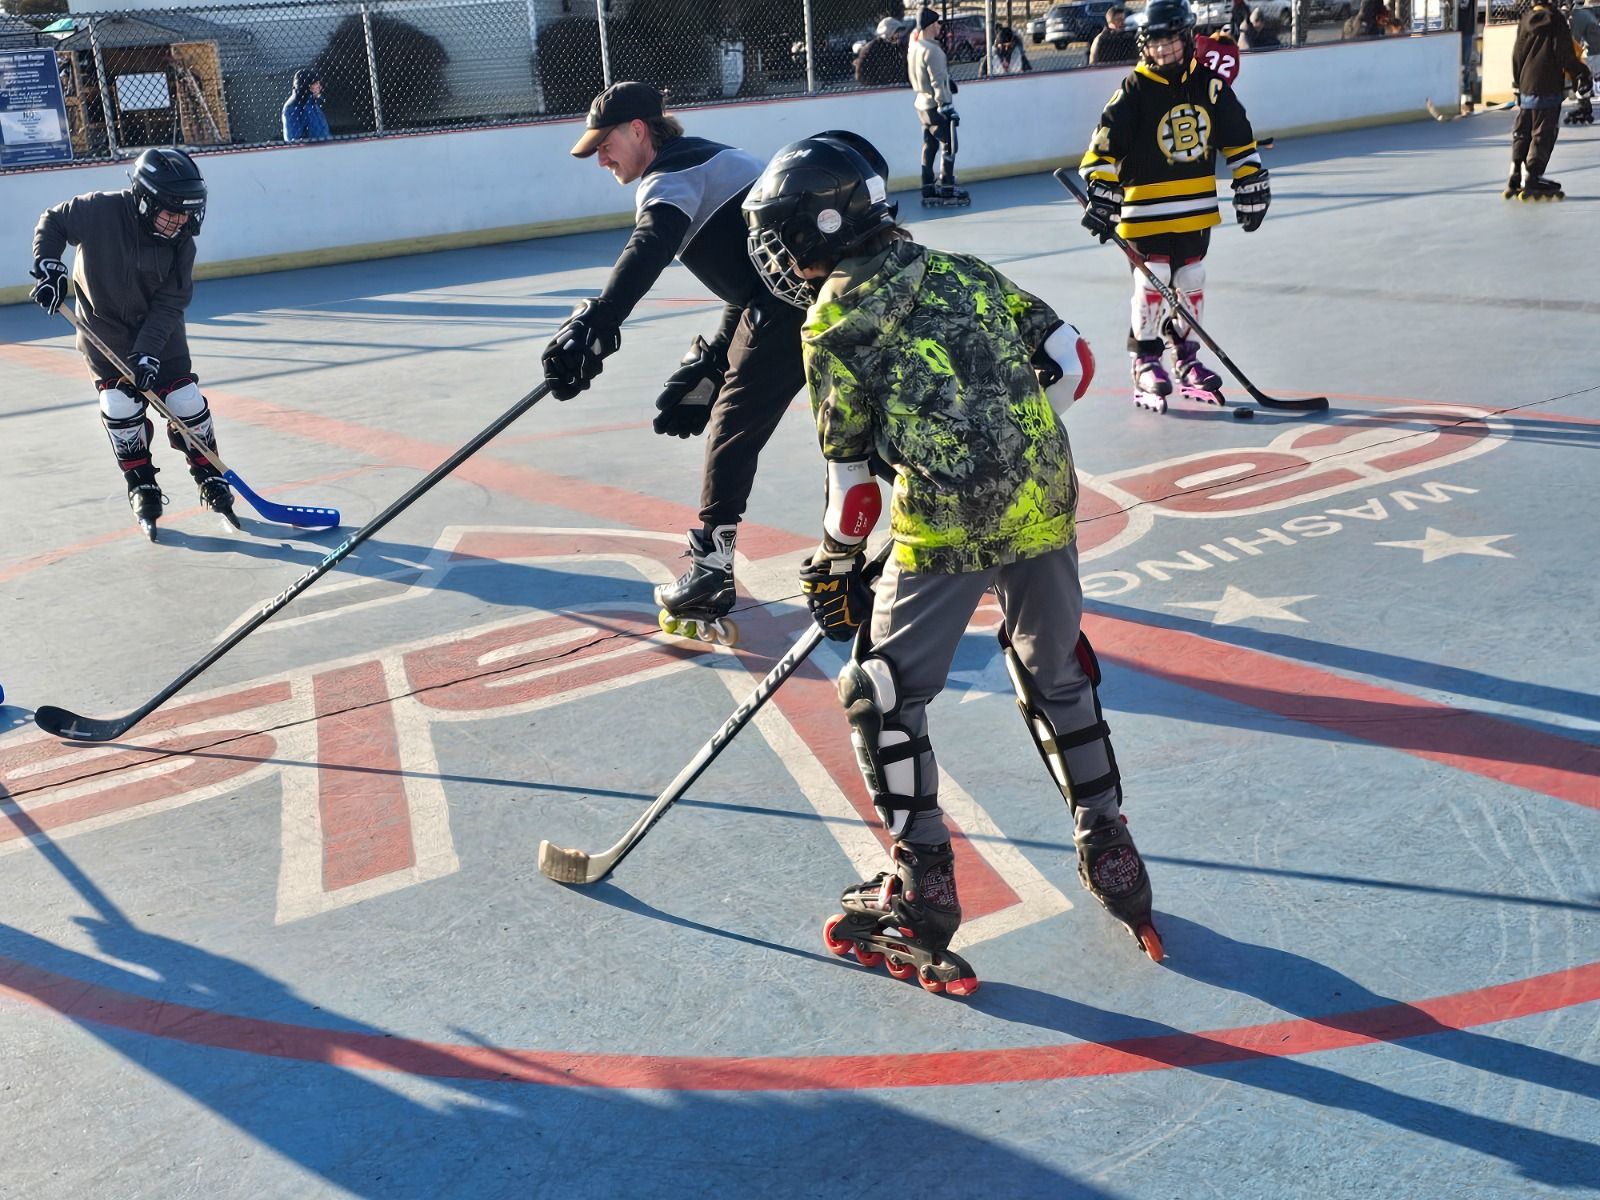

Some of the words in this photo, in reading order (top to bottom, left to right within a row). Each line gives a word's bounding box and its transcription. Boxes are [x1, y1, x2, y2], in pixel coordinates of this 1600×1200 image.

[1204, 50, 1235, 78] 32
[1208, 78, 1223, 105] C
[1173, 115, 1199, 150] B
